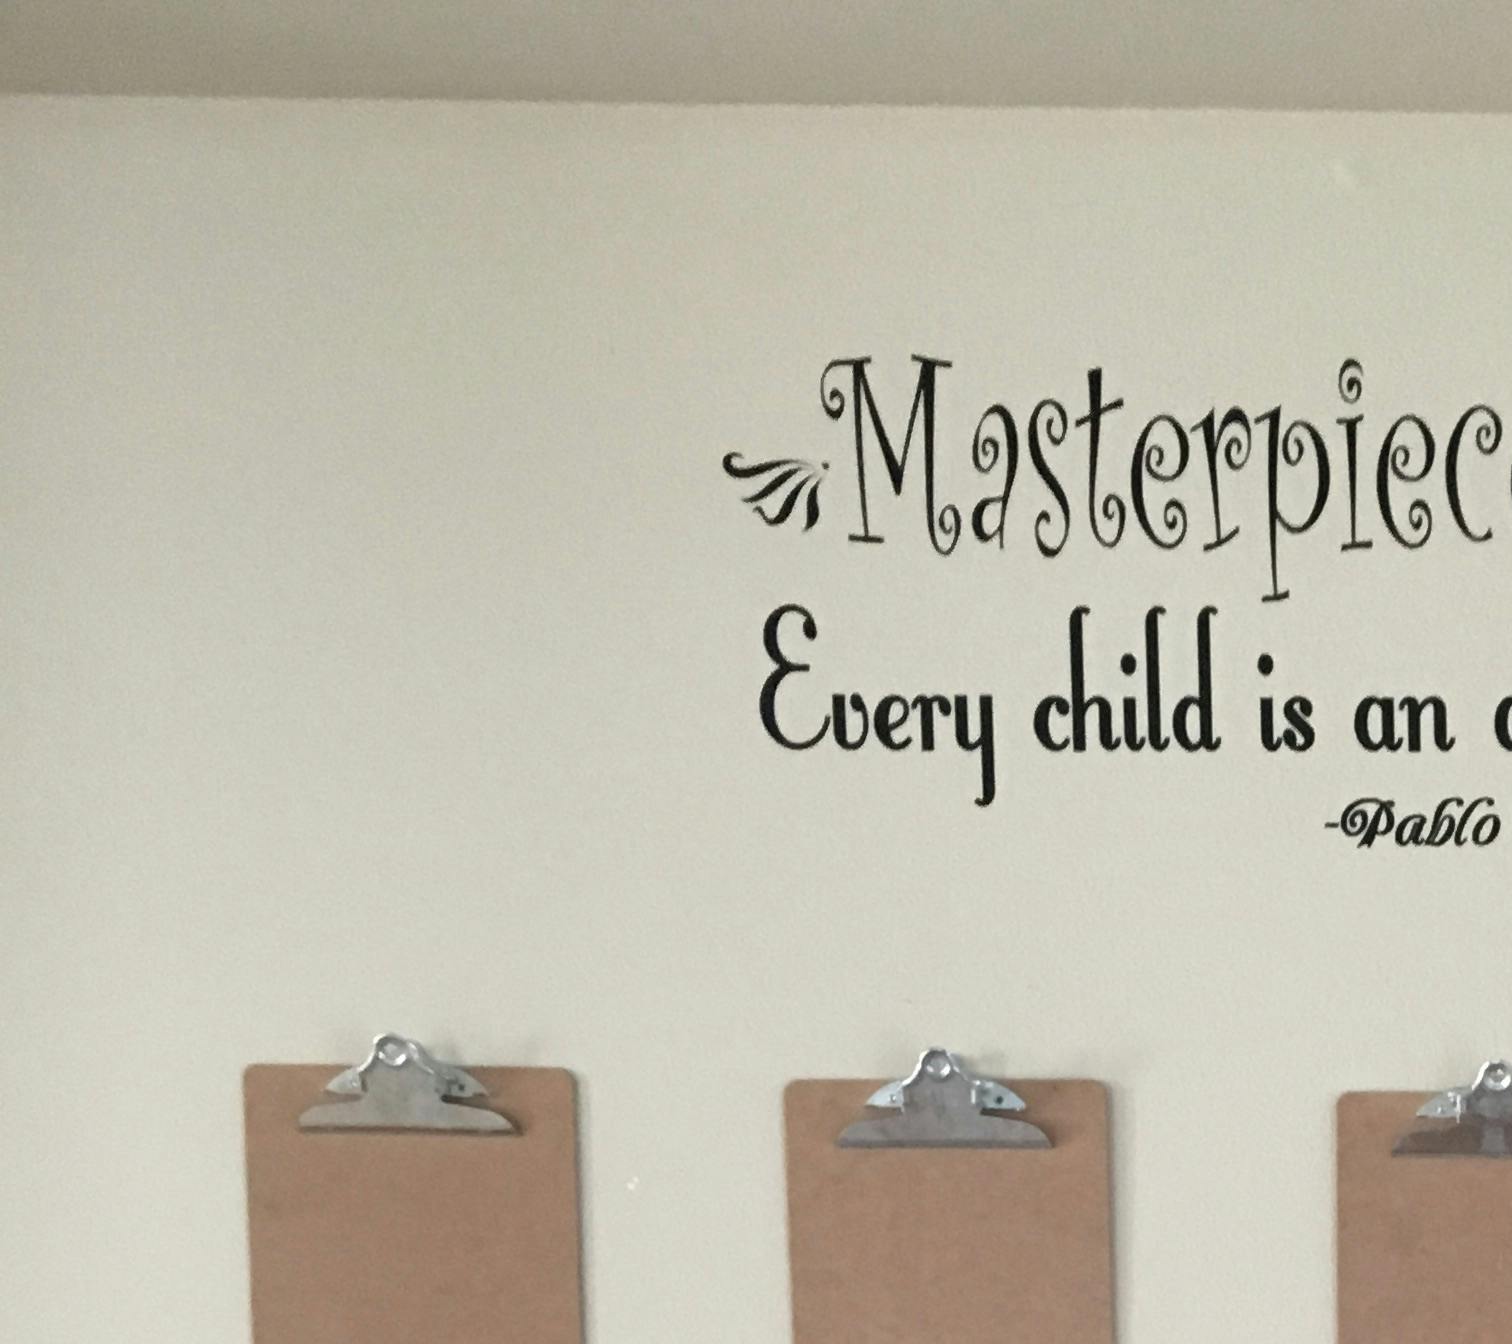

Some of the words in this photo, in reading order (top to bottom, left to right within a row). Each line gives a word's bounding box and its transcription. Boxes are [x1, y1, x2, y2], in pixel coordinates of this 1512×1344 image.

[758, 603, 996, 809] Every
[1033, 604, 1223, 754] child
[1257, 652, 1317, 754] is
[1353, 694, 1457, 754] an
